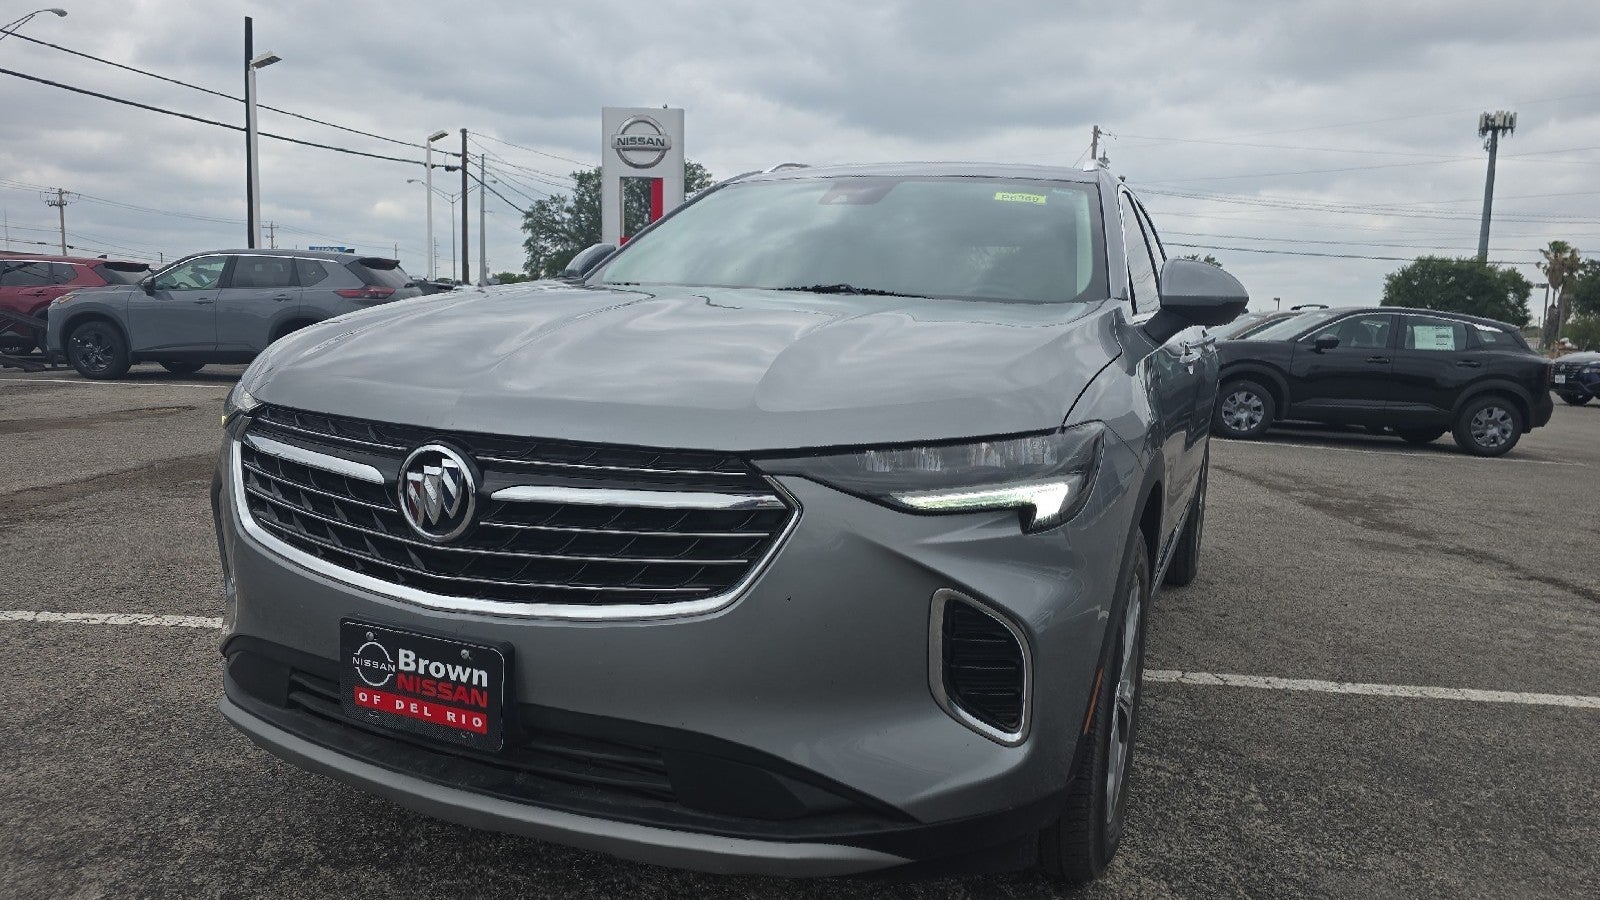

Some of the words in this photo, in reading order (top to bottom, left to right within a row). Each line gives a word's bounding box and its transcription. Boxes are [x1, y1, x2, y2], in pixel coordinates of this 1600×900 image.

[617, 137, 664, 146] NISSAN
[352, 656, 395, 672] NISSAN
[398, 648, 488, 687] Brown
[397, 672, 488, 707] NISSAN
[358, 692, 381, 705] OF
[395, 699, 432, 717] DEL
[446, 711, 483, 728] RIO
